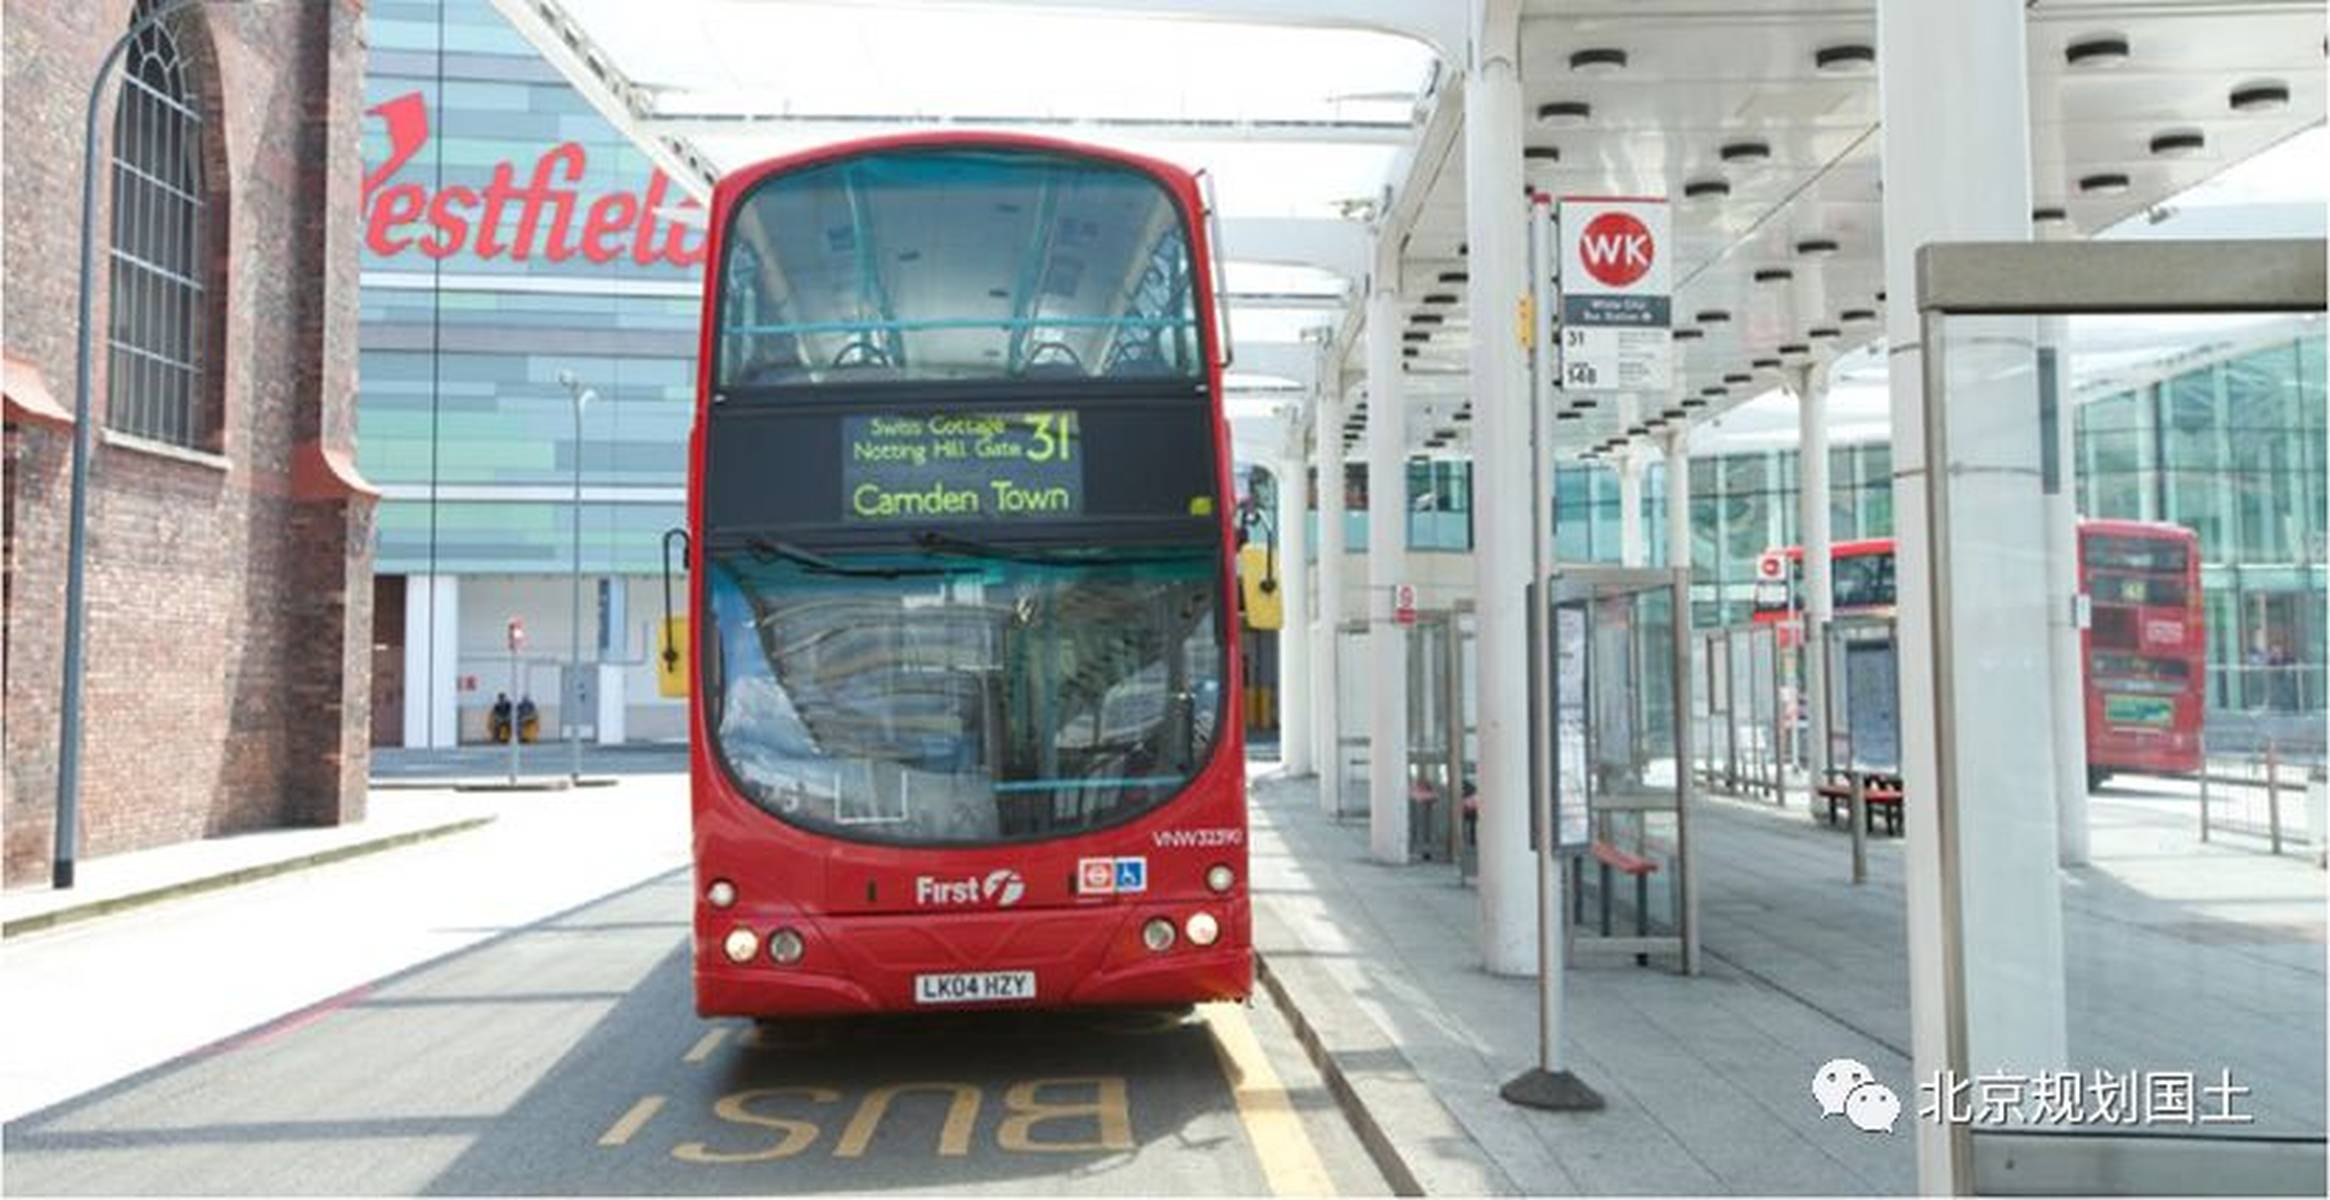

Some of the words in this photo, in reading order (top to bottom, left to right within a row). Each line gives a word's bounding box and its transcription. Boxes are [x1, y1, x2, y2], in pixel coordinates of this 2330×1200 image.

[1584, 234, 1649, 266] WK
[1567, 331, 1585, 347] 31
[853, 441, 927, 466] Notting
[933, 439, 966, 459] Hill
[974, 440, 1022, 459] Gate
[1025, 414, 1071, 461] 31
[853, 482, 979, 515] Camden
[989, 480, 1070, 511] Town
[916, 875, 979, 904] First
[923, 976, 979, 998] LK04
[984, 974, 1027, 996] HZY
[671, 1075, 1138, 1163] BUS
